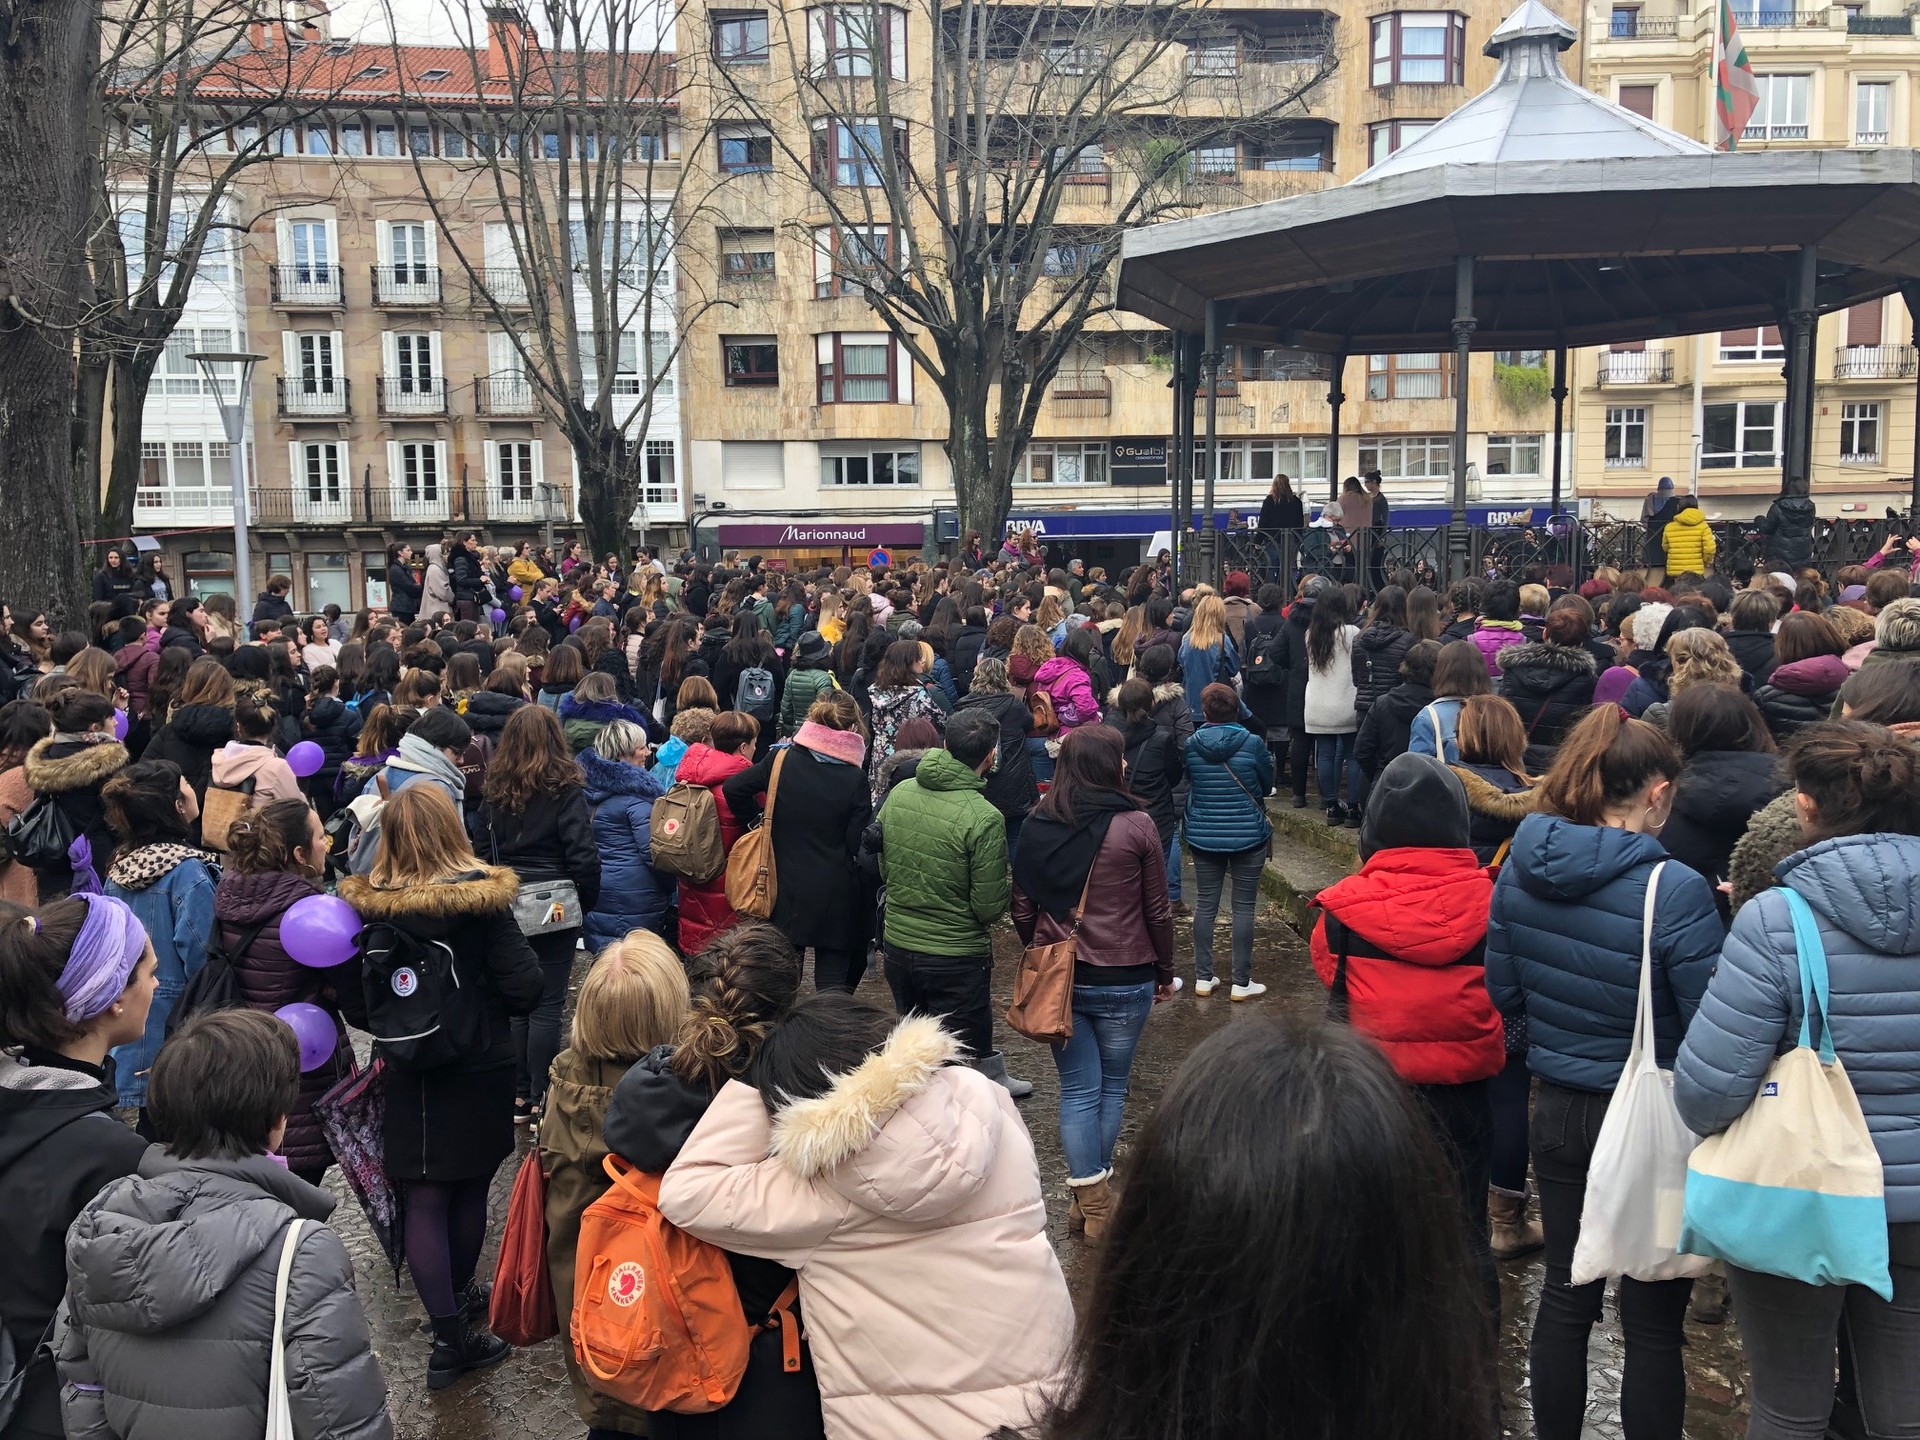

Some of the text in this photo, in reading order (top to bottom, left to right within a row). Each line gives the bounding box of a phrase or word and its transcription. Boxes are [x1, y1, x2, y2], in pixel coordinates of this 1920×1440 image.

[1126, 447, 1164, 456] Gualbi
[1006, 519, 1046, 534] BBVA
[779, 525, 866, 544] Marionnaud
